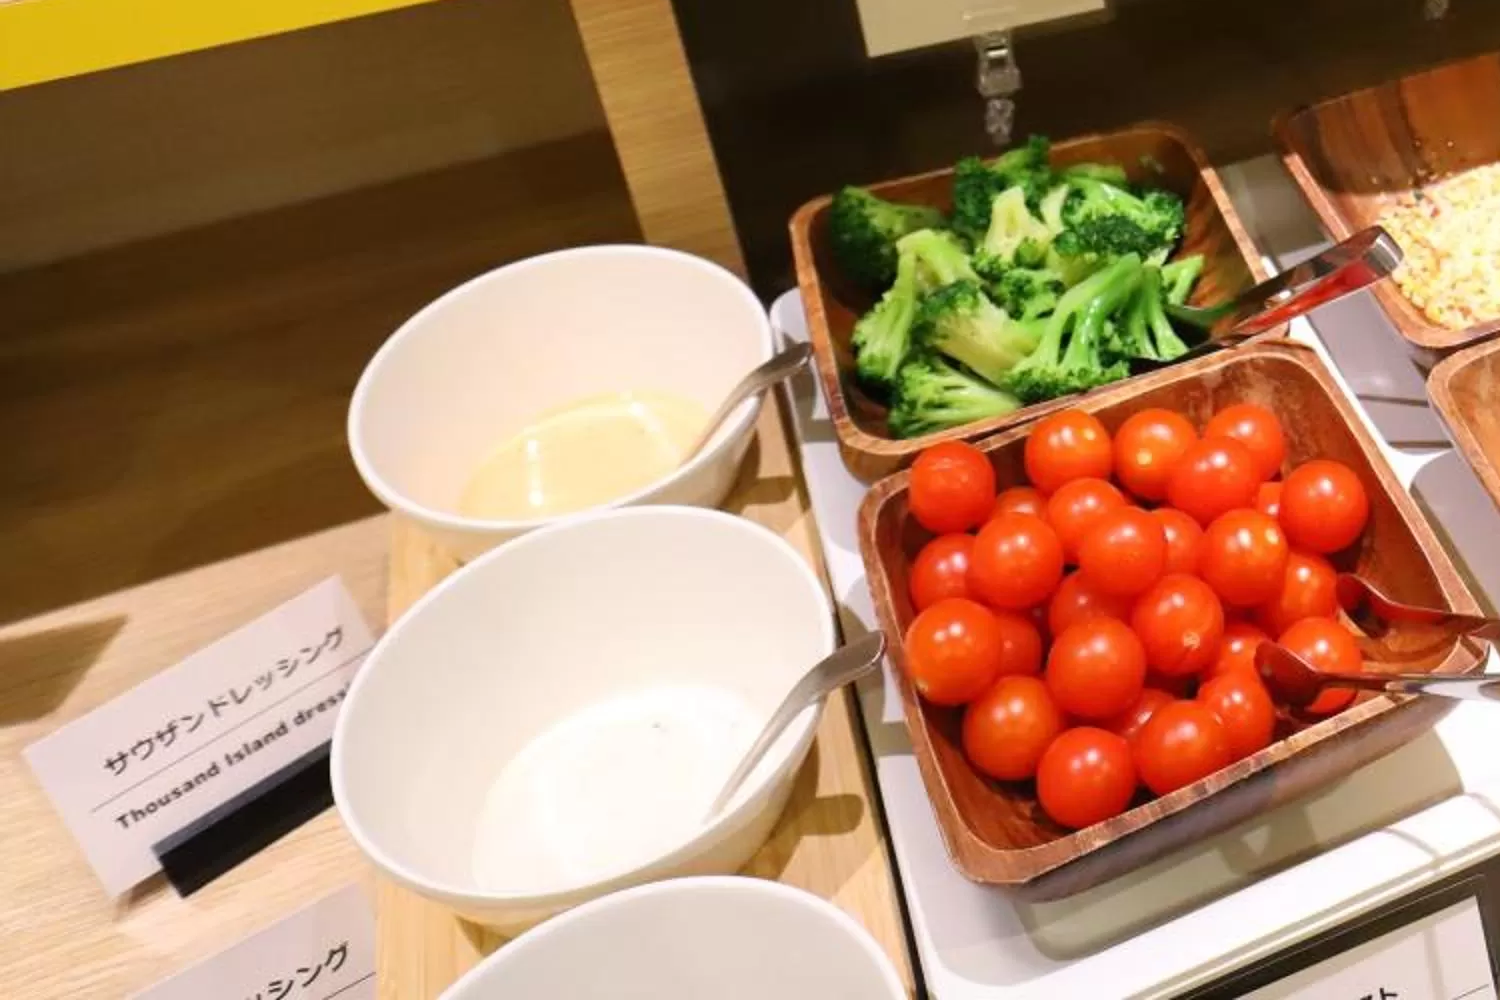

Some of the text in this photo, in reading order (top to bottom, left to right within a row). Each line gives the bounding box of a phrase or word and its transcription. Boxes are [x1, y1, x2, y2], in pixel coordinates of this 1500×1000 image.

[103, 624, 345, 777] サウザンドレッシング
[114, 762, 220, 830] Thousand
[224, 722, 290, 768] Island
